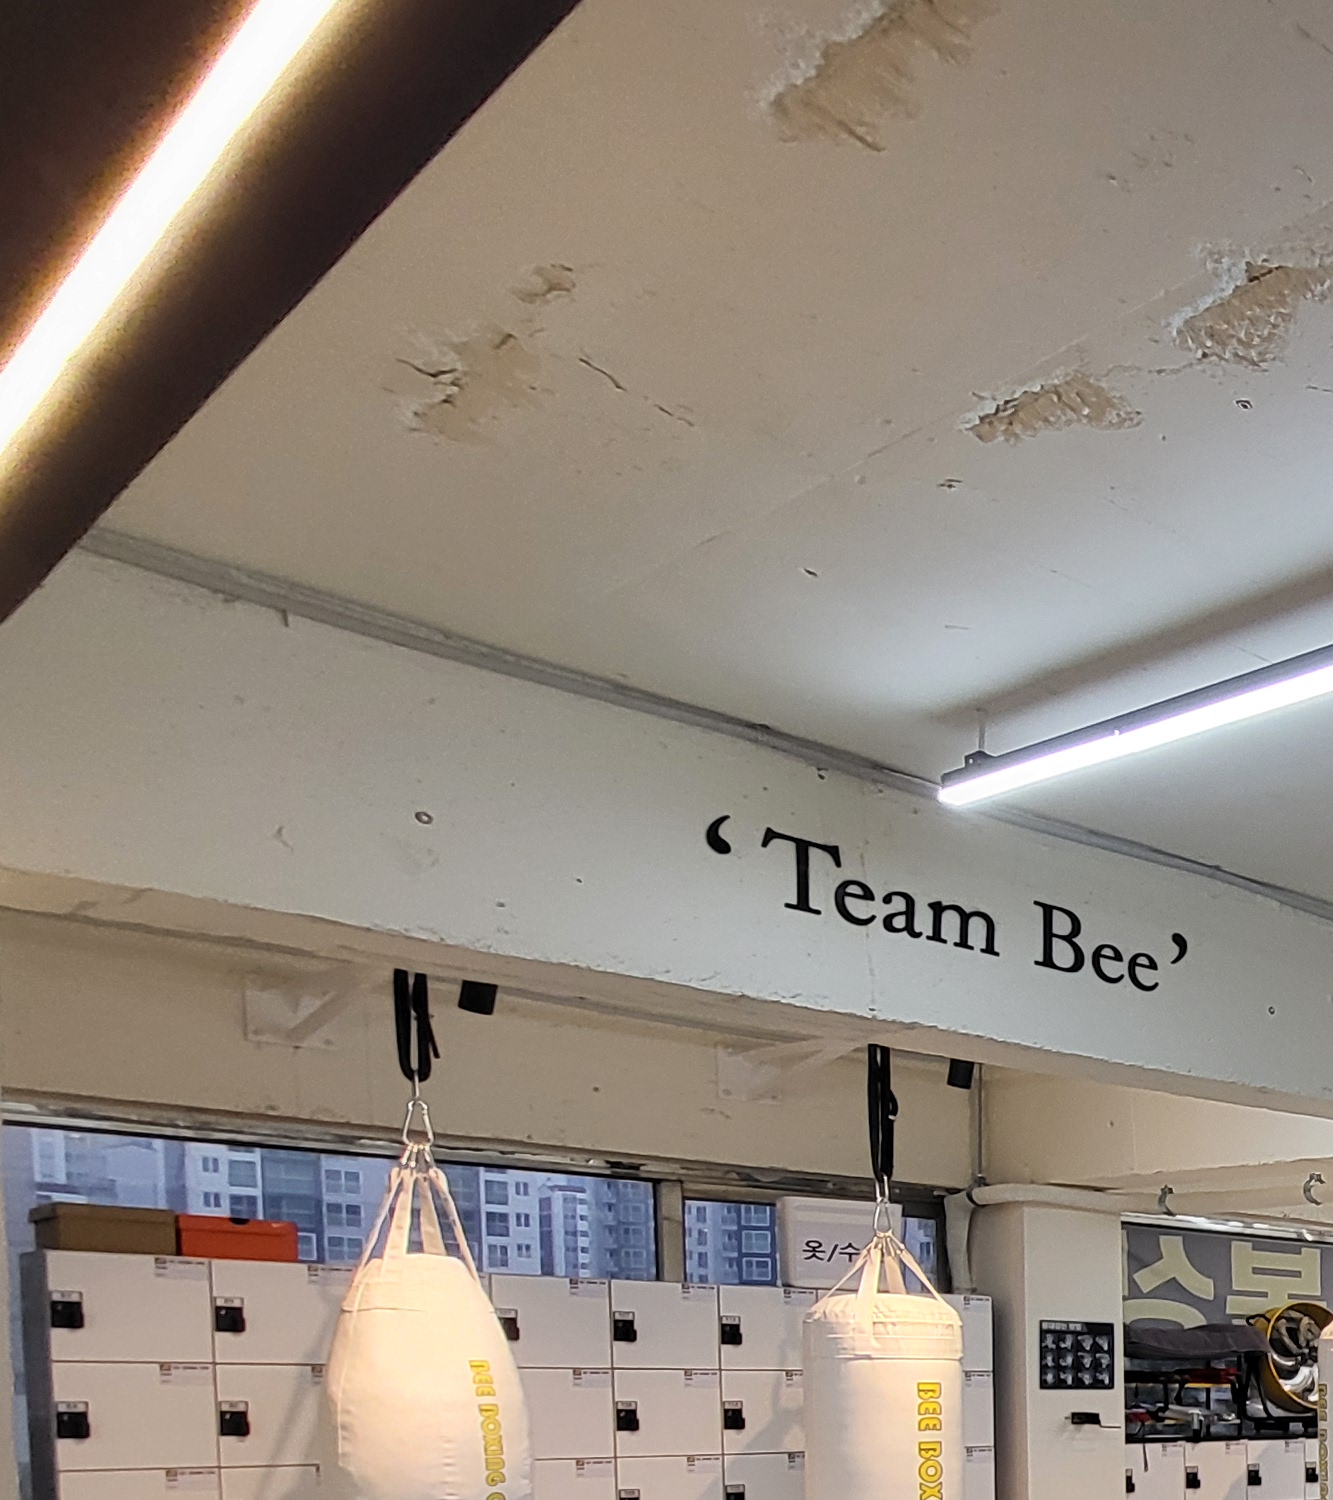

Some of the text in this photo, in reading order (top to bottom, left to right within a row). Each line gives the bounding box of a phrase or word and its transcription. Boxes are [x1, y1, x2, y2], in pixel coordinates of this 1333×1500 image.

[802, 1240, 864, 1263] 옷/수
[468, 1360, 496, 1397] BEE
[917, 1382, 942, 1431] BEE
[478, 1404, 507, 1487] BOXING
